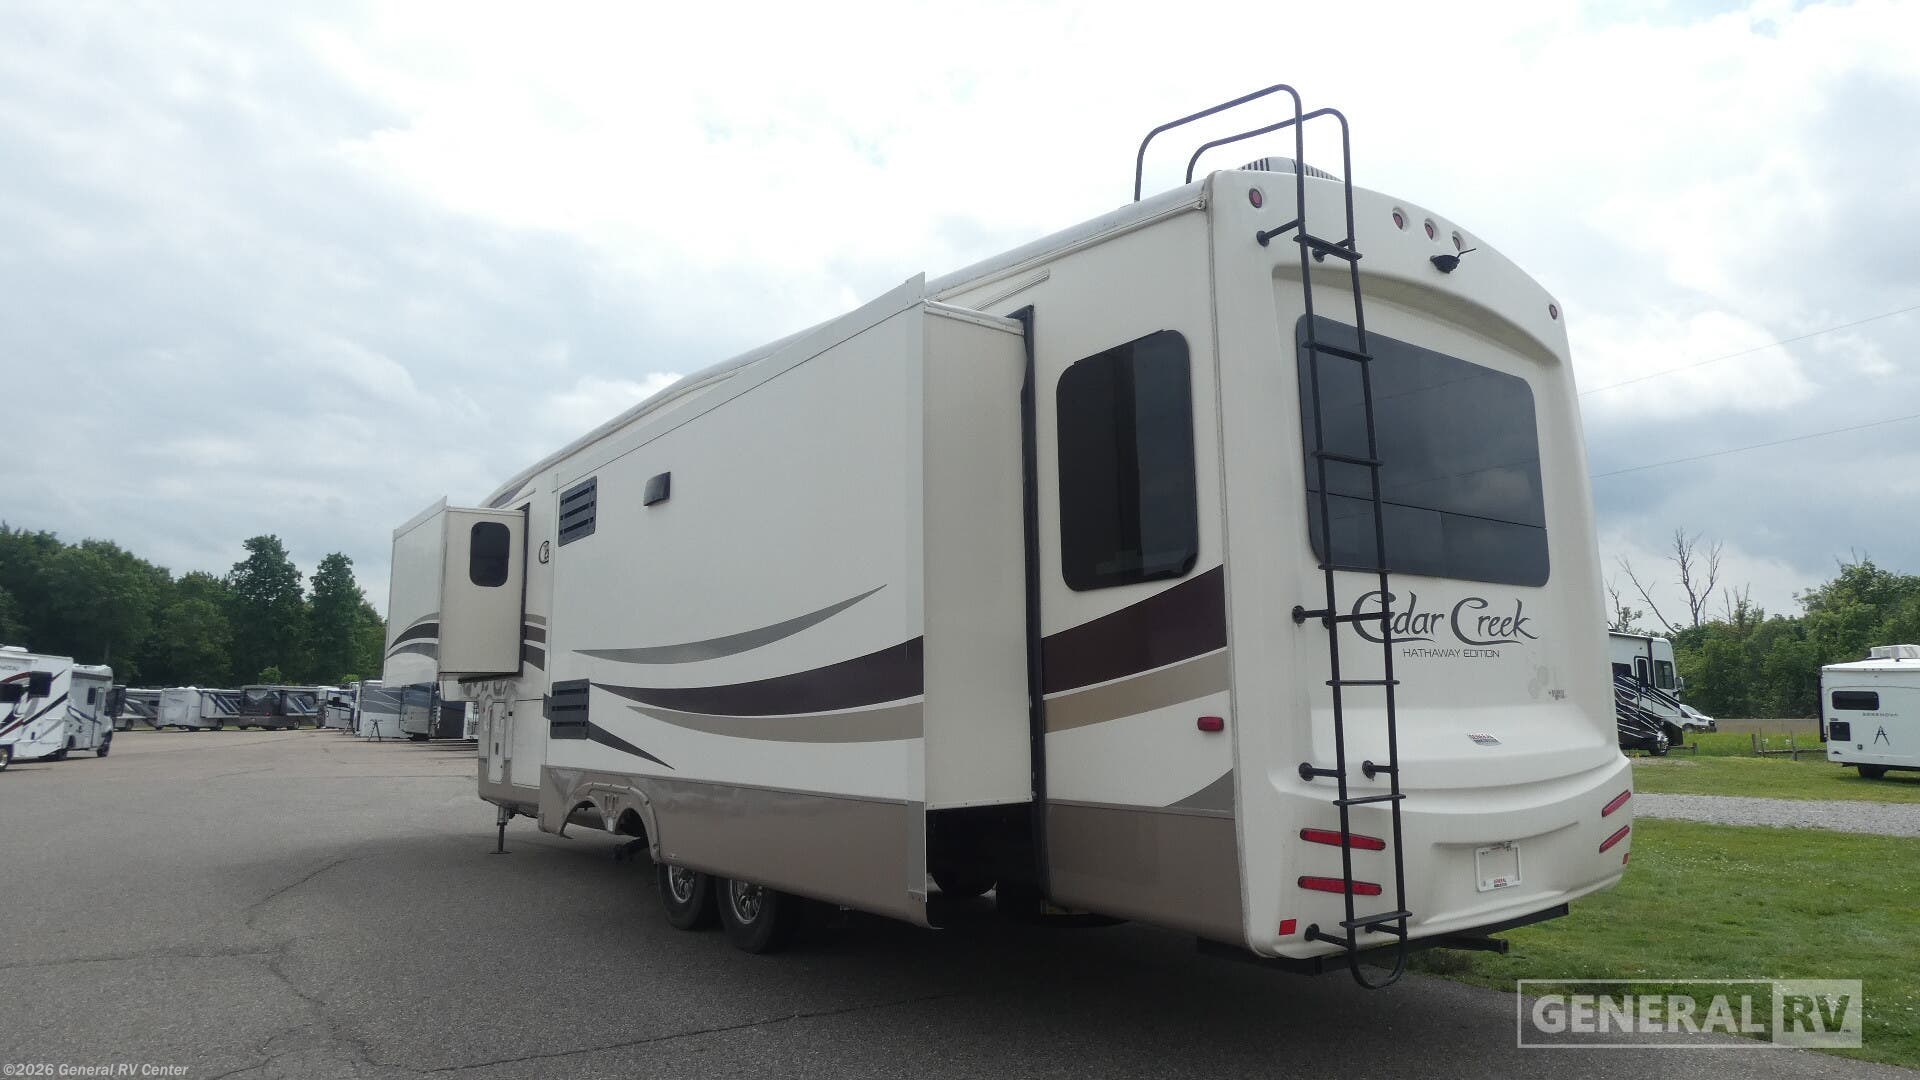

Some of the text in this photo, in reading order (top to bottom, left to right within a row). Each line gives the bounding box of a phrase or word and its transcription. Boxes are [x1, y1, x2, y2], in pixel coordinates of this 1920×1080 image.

[1451, 597, 1539, 645] Creek
[1403, 648, 1500, 658] HATHAWAY EDITION
